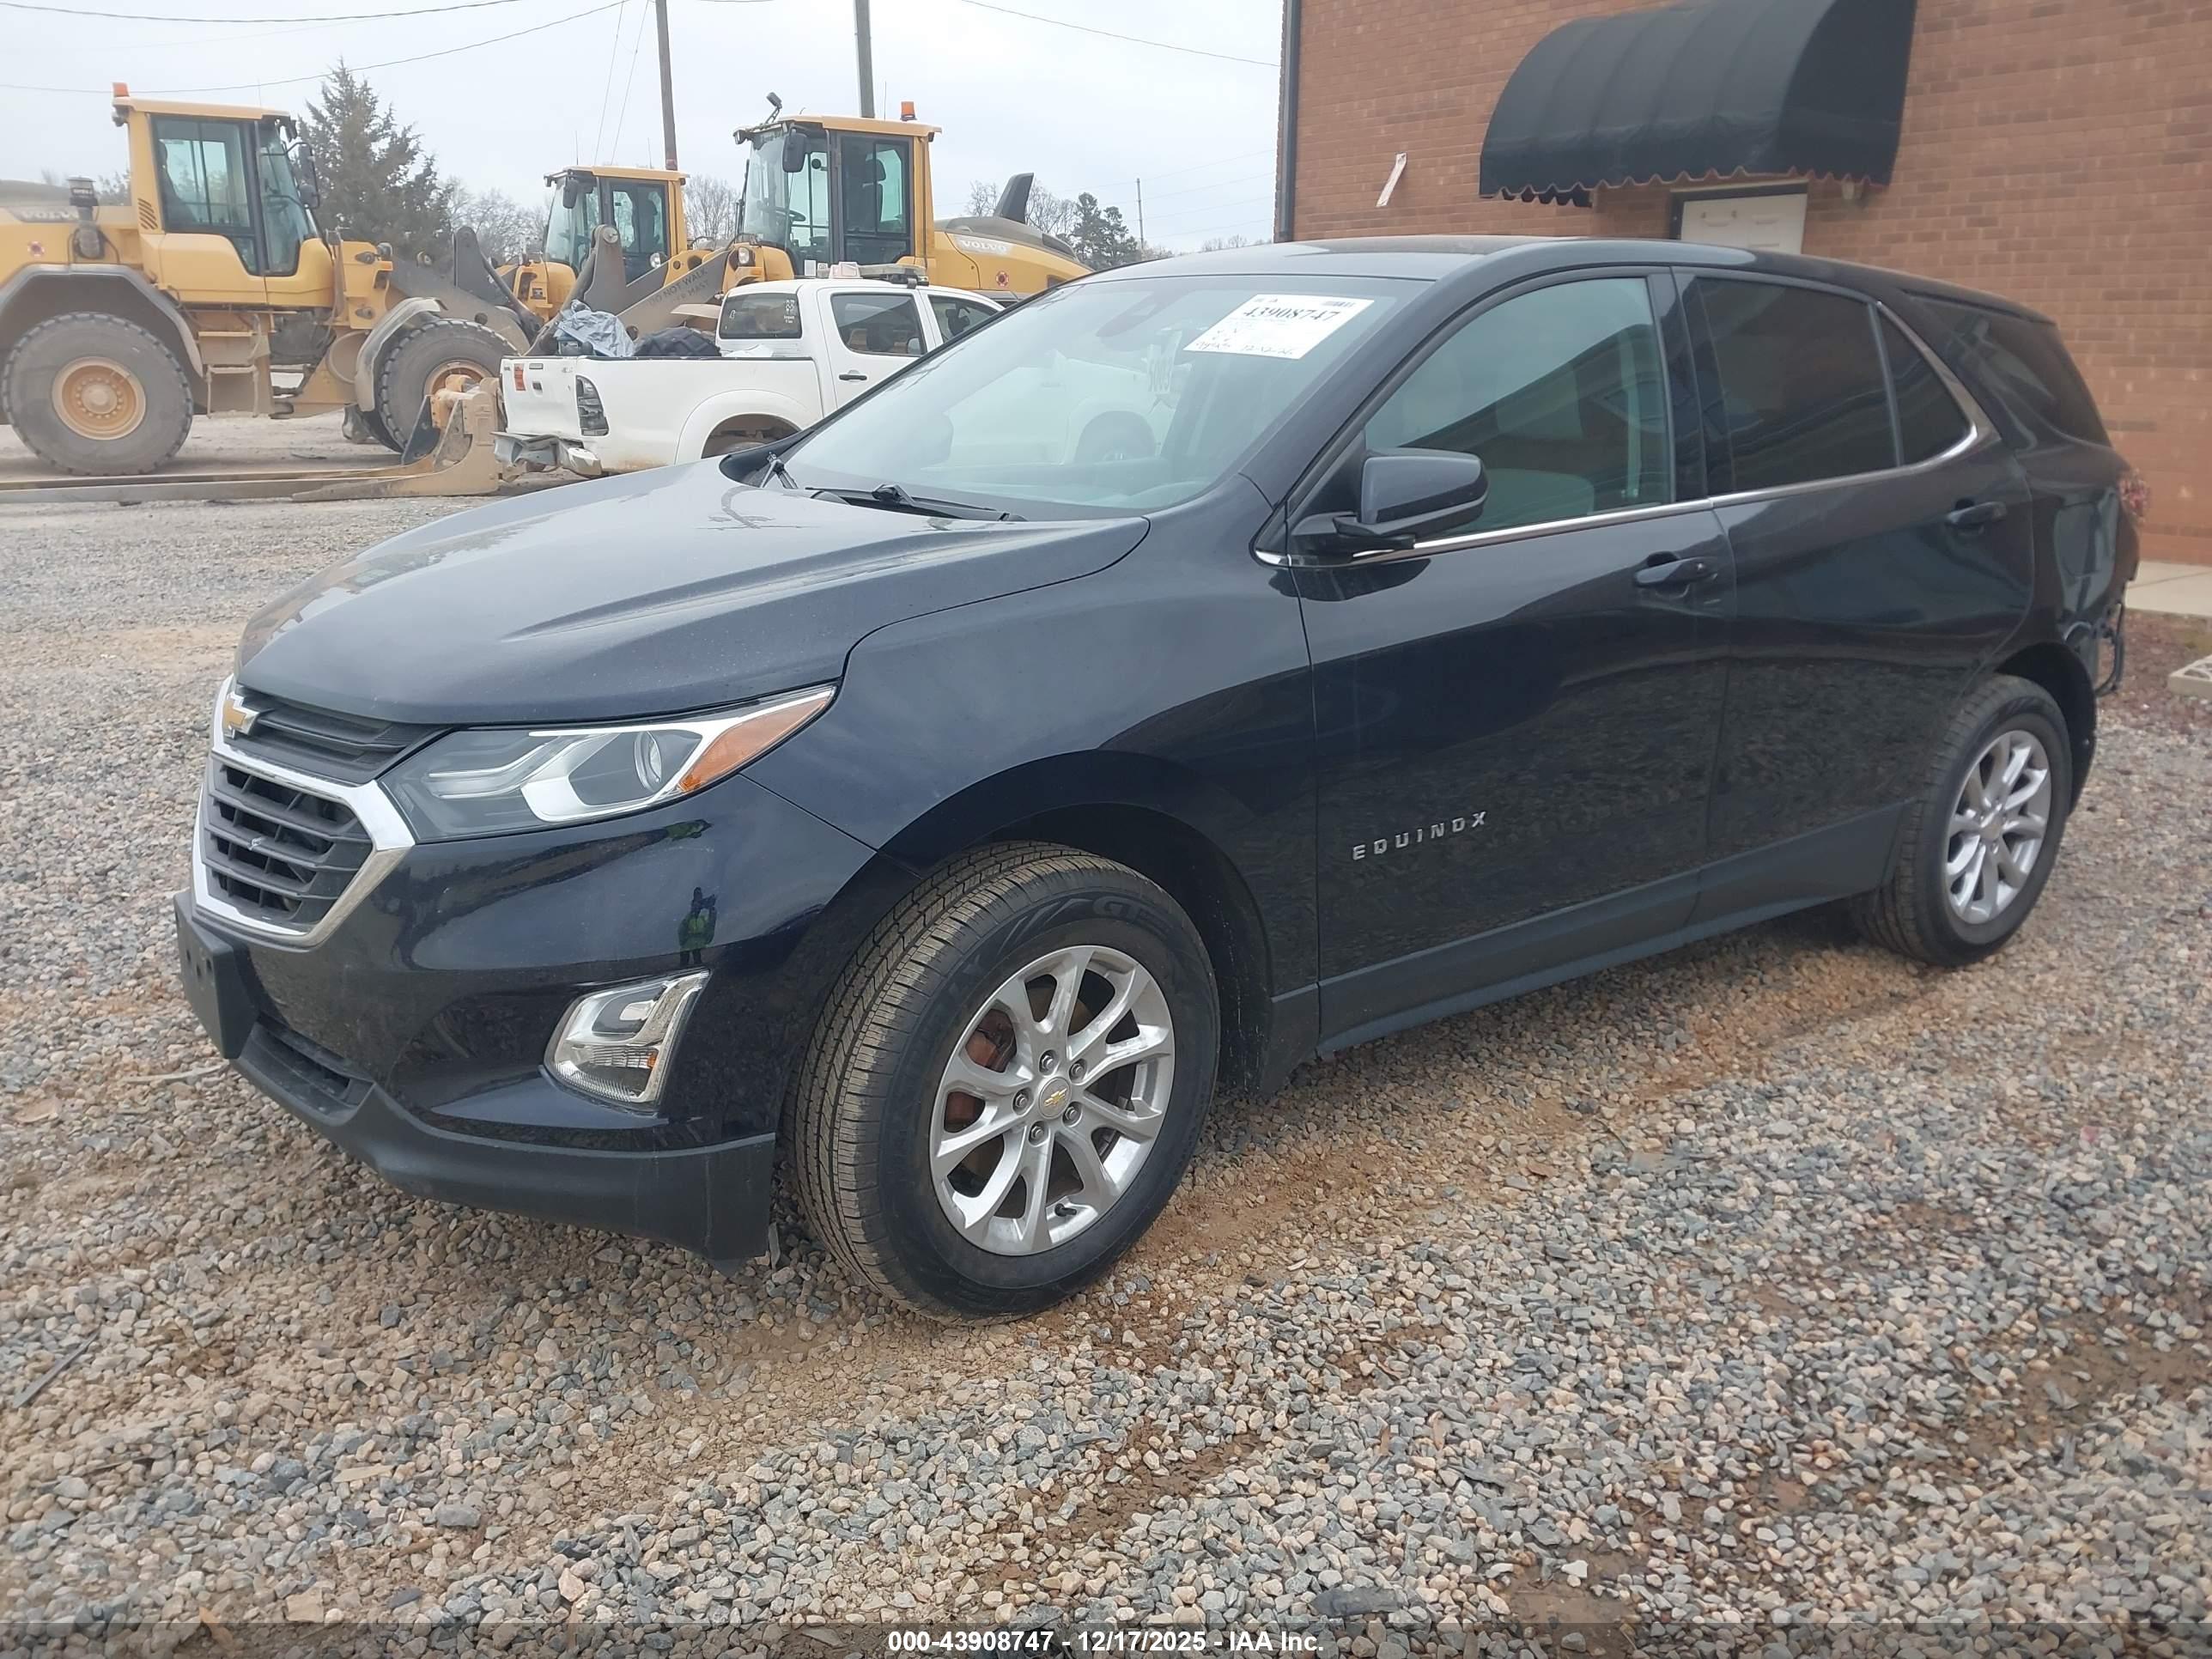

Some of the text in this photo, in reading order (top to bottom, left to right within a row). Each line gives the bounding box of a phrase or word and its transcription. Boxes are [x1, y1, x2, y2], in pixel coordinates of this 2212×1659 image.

[960, 240, 1007, 252] VOLVO
[663, 283, 682, 297] NOT
[682, 268, 708, 286] WALK
[1243, 306, 1341, 321] 43908747
[1352, 811, 1486, 860] EQUINOX
